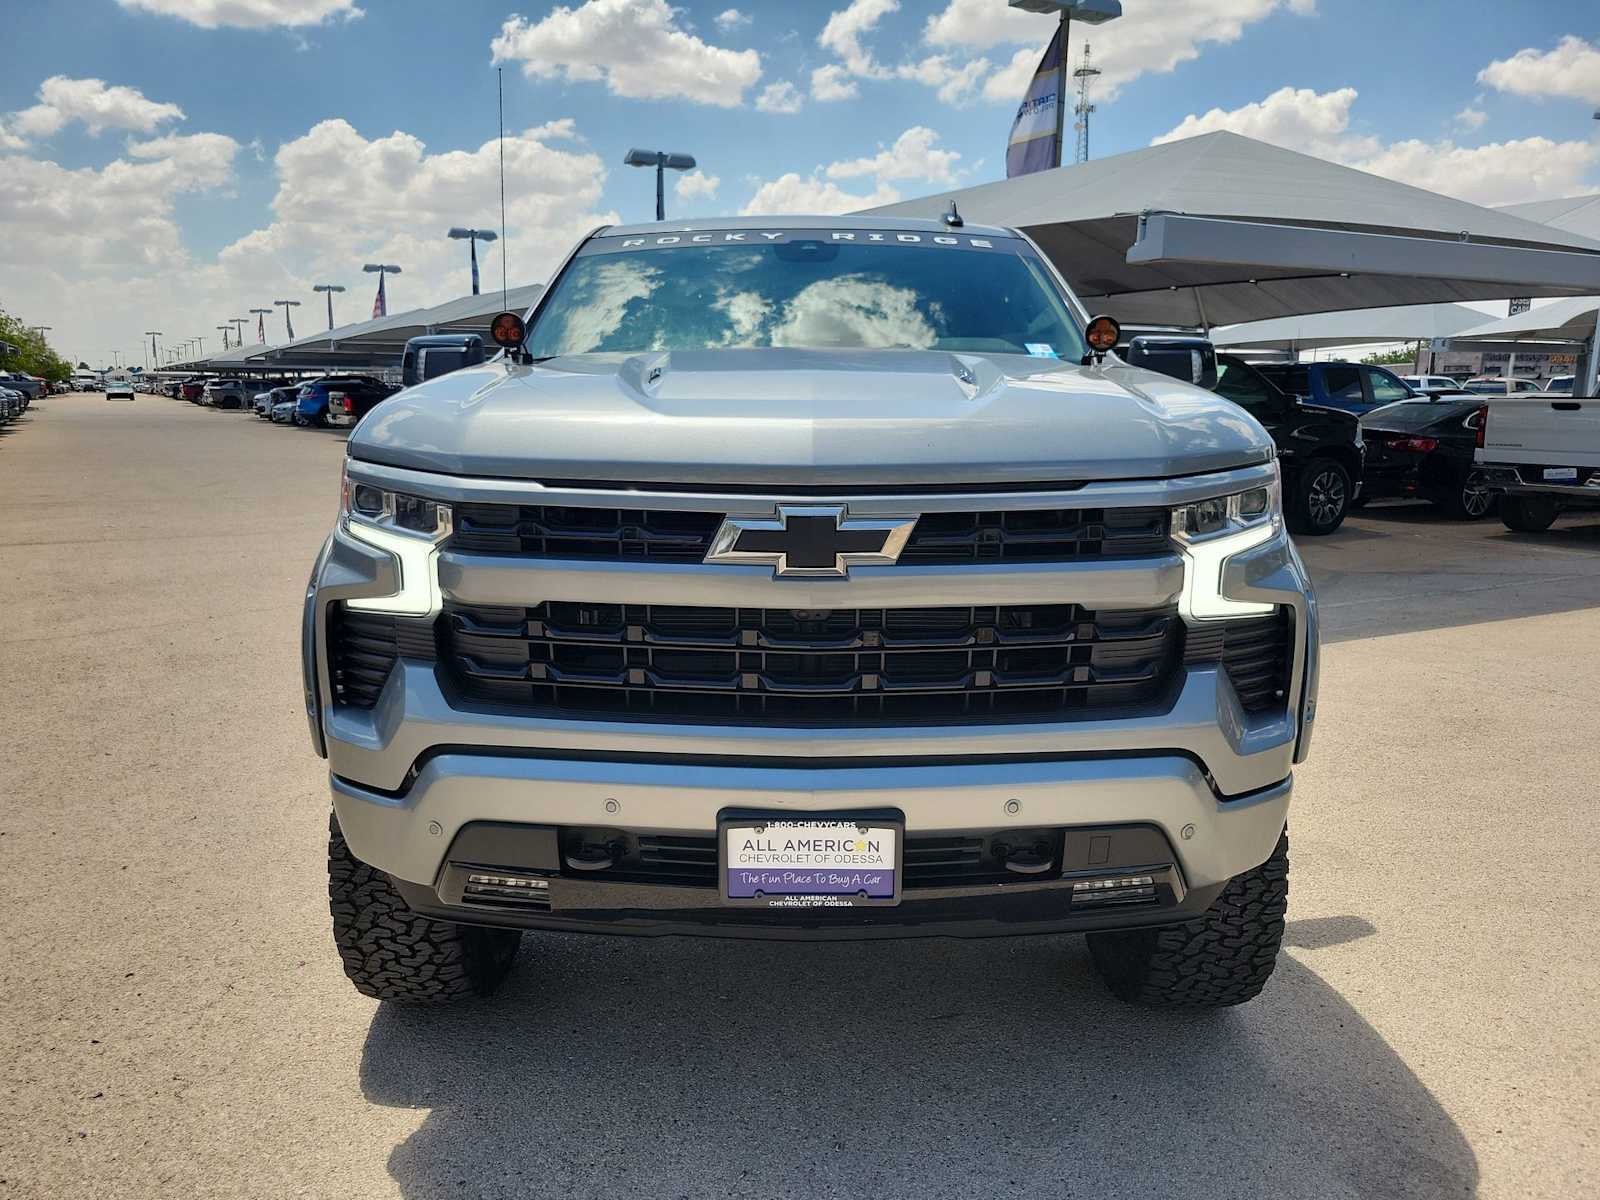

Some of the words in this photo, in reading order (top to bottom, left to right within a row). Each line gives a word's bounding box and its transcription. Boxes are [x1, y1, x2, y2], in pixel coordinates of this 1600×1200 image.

[622, 232, 783, 247] ROCKY
[831, 232, 993, 248] RIDGE
[742, 839, 777, 852] ALL
[739, 853, 811, 863] CHEVROLET
[814, 854, 830, 864] OF
[834, 854, 883, 864] ODESSA
[740, 872, 759, 884] The
[761, 872, 781, 884] Fun
[783, 872, 811, 884] Place
[813, 873, 826, 884] To
[829, 873, 849, 888] Buy
[851, 873, 861, 885] A
[863, 873, 882, 885] Car
